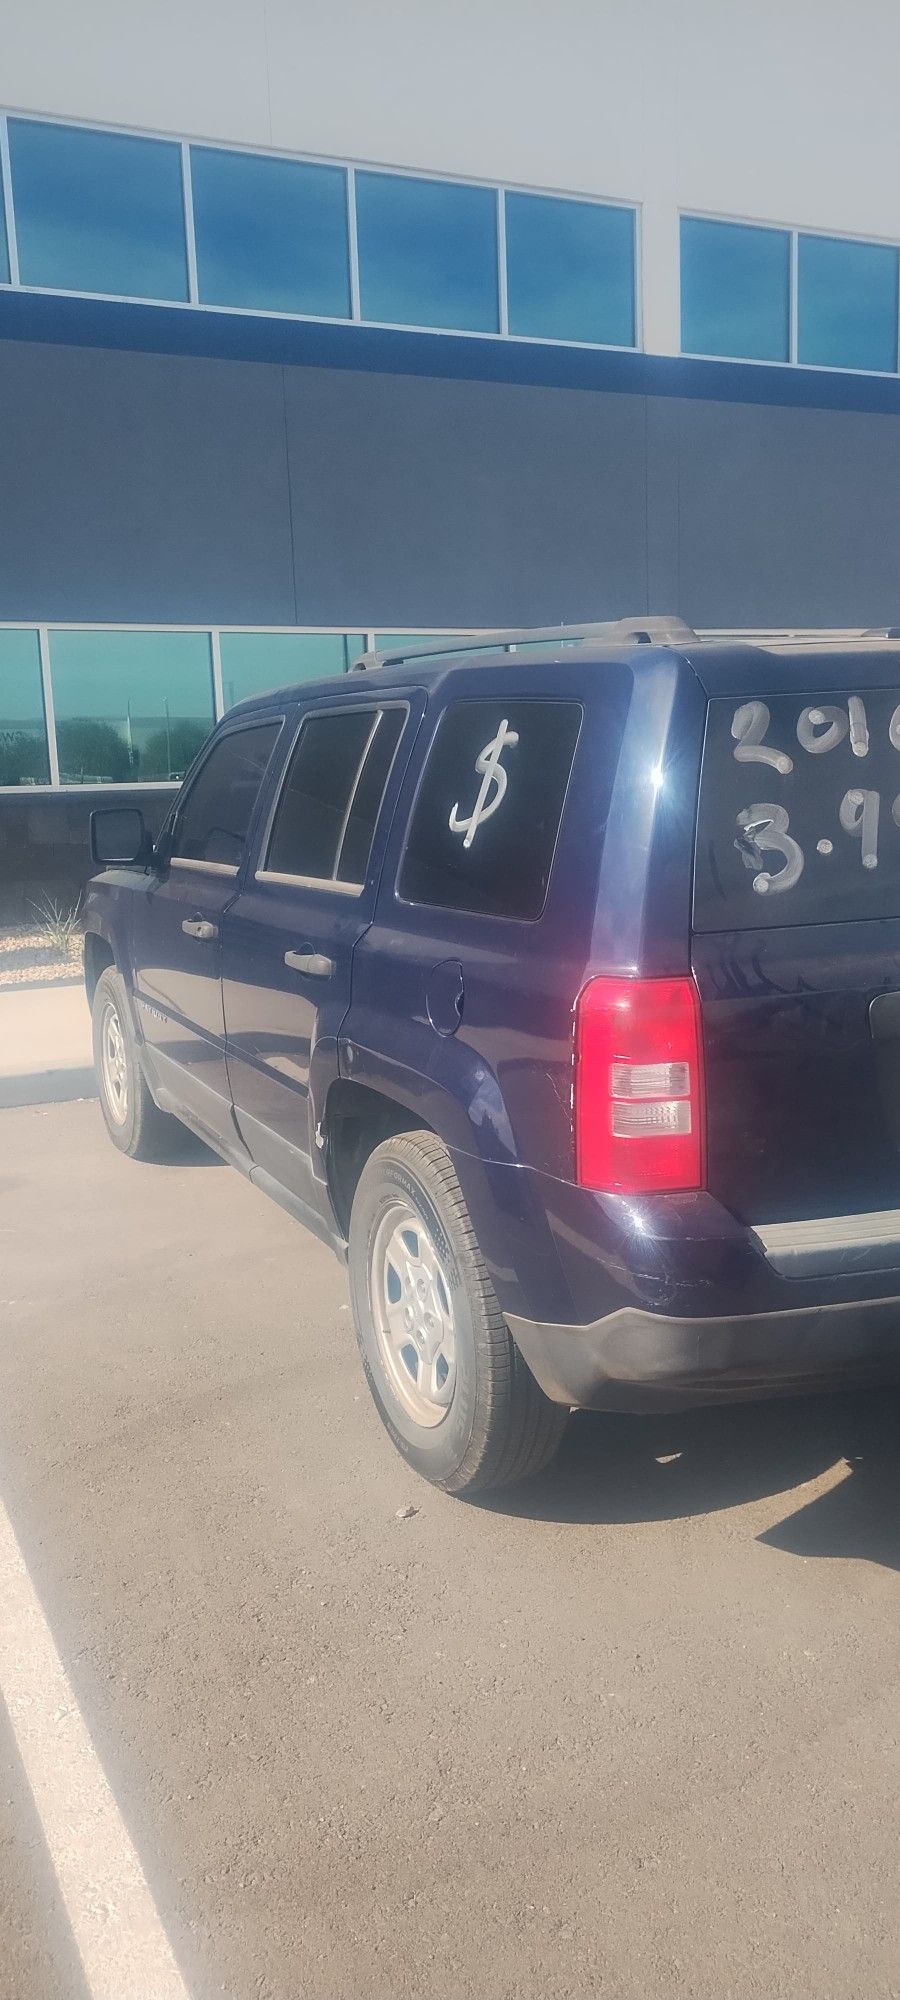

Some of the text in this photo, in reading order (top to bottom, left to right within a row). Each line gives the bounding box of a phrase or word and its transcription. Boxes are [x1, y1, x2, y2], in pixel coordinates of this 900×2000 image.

[449, 719, 520, 849] $
[731, 695, 900, 775] 201
[734, 788, 900, 896] 3.9
